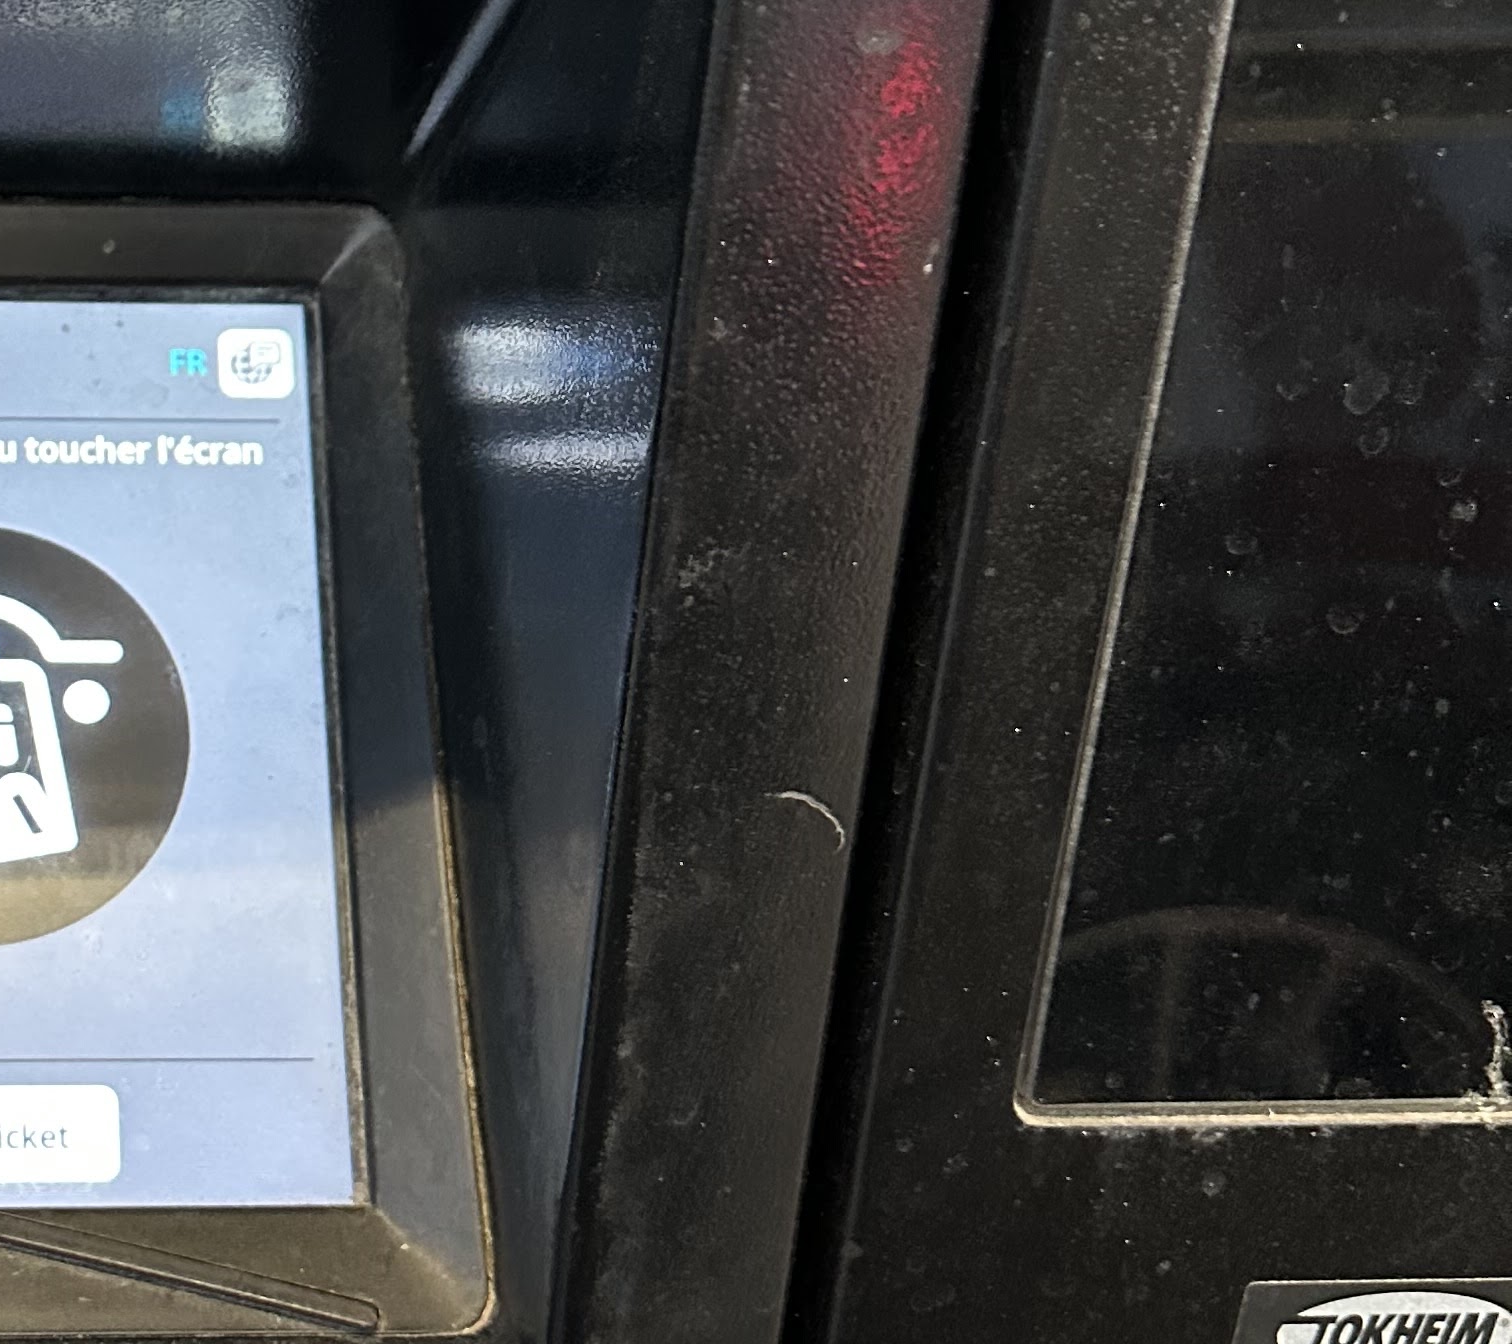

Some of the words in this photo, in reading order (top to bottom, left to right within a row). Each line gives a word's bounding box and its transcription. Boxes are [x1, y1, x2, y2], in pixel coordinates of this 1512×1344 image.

[168, 348, 207, 376] FR
[24, 434, 151, 465] toucher
[157, 434, 264, 465] l'écran
